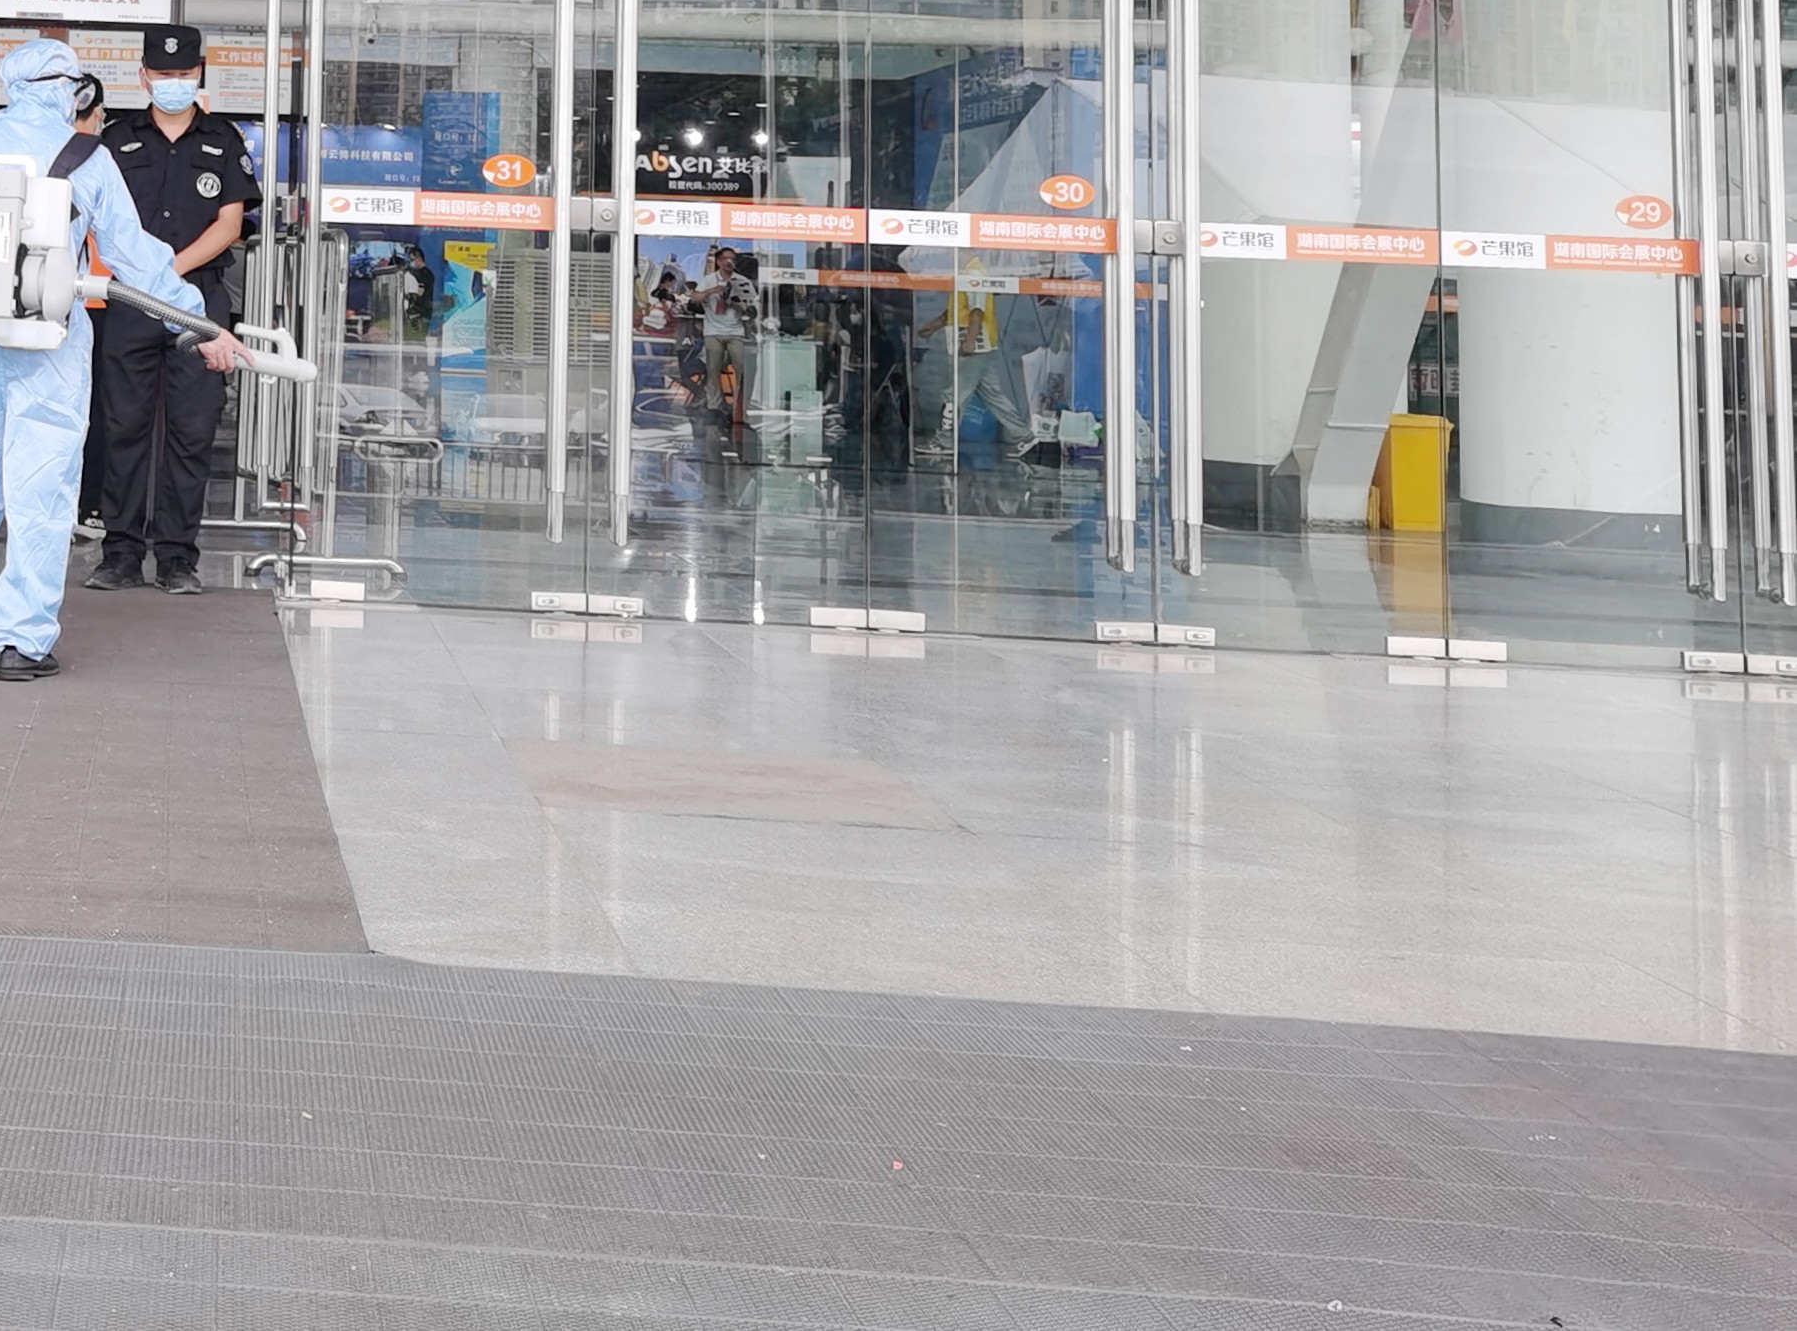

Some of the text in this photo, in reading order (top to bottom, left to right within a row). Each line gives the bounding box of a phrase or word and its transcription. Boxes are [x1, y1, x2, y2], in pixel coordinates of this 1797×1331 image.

[497, 160, 522, 181] 31
[635, 150, 713, 179] Absen
[1054, 182, 1084, 202] 30
[354, 197, 542, 218] 芒果馆 湖南国际会展中心
[1629, 202, 1662, 222] 29
[659, 209, 856, 229] 芒果馆 湖南国际会展中心
[907, 218, 1106, 239] 芒果馆 湖南国际会展中心
[1221, 230, 1425, 252] 芒果馆 湖南国际会展中心
[1481, 240, 1684, 262] 芒果馆 湖南国际会展中心
